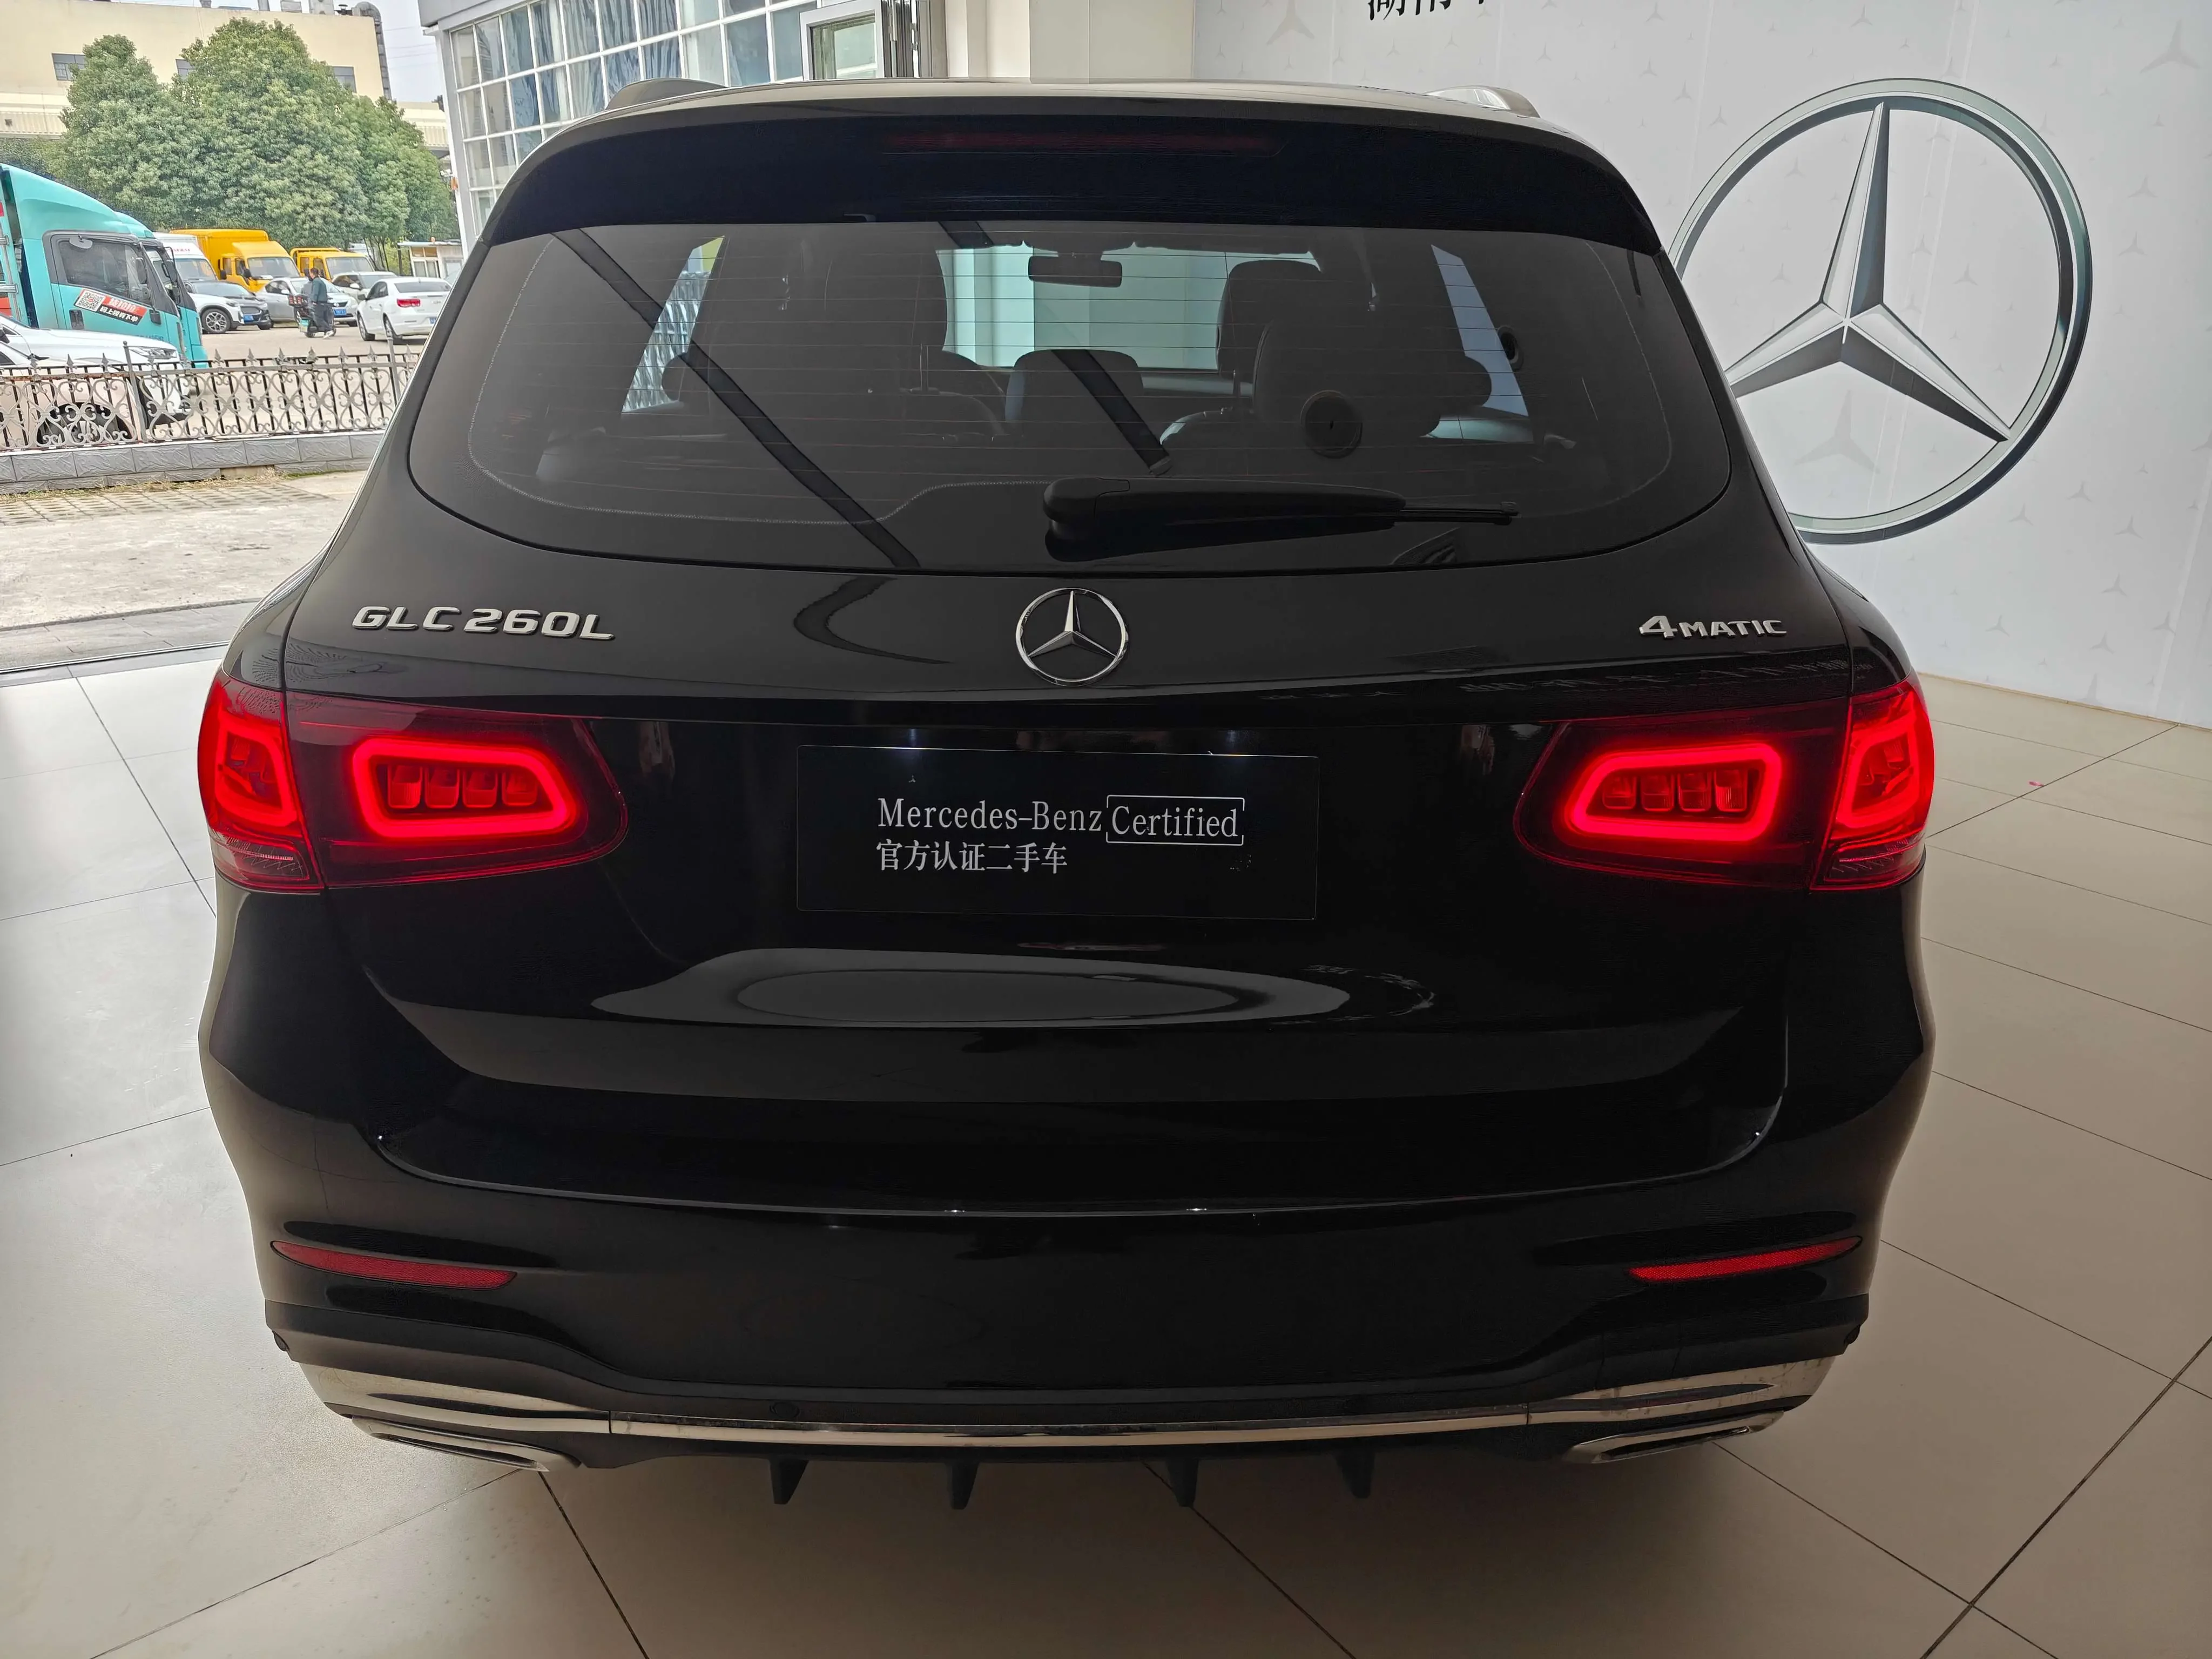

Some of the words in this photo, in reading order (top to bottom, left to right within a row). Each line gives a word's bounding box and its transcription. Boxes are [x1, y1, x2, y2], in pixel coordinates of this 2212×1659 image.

[352, 606, 462, 631] GLC
[463, 608, 615, 640] 260L
[1639, 615, 1787, 638] 4MATIC
[878, 798, 1102, 832] Mercedes-Benz
[1111, 806, 1238, 838] Certified
[876, 839, 1068, 874] 官方认证二手车
